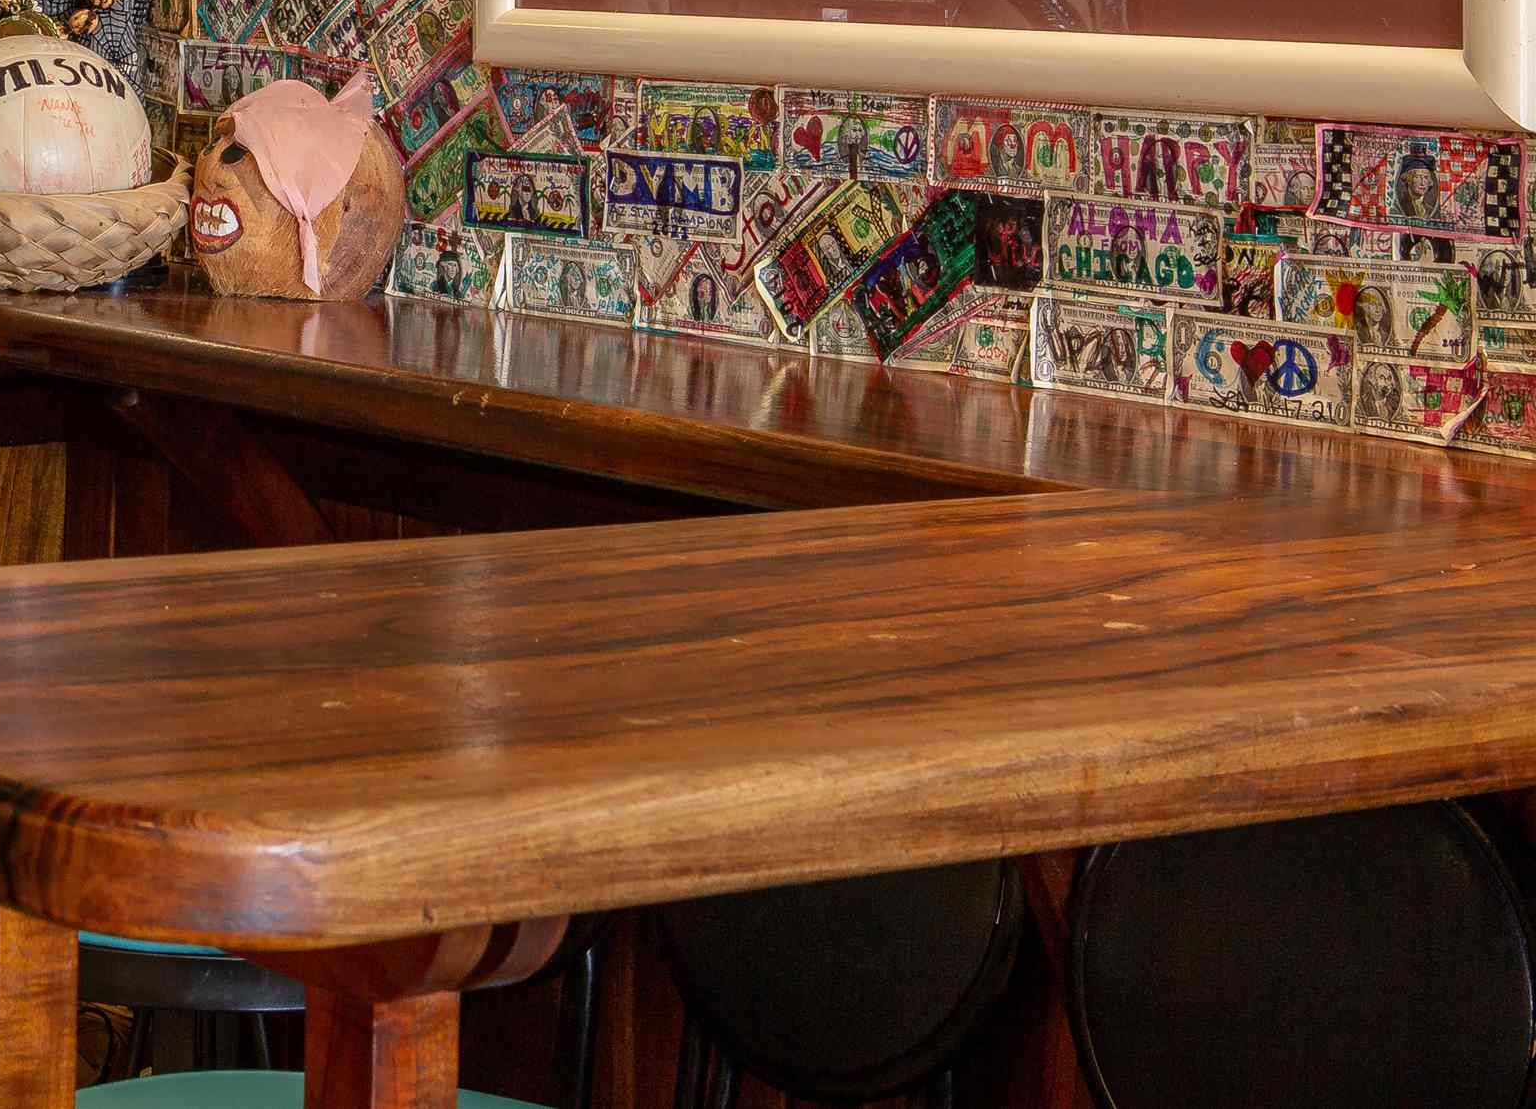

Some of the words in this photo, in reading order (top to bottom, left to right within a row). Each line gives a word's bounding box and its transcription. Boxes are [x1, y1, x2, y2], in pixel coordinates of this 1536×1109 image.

[1099, 133, 1248, 202] HAPPY
[630, 205, 663, 221] STATE
[1068, 201, 1186, 246] ALOHA
[1057, 243, 1196, 289] CHICAGO
